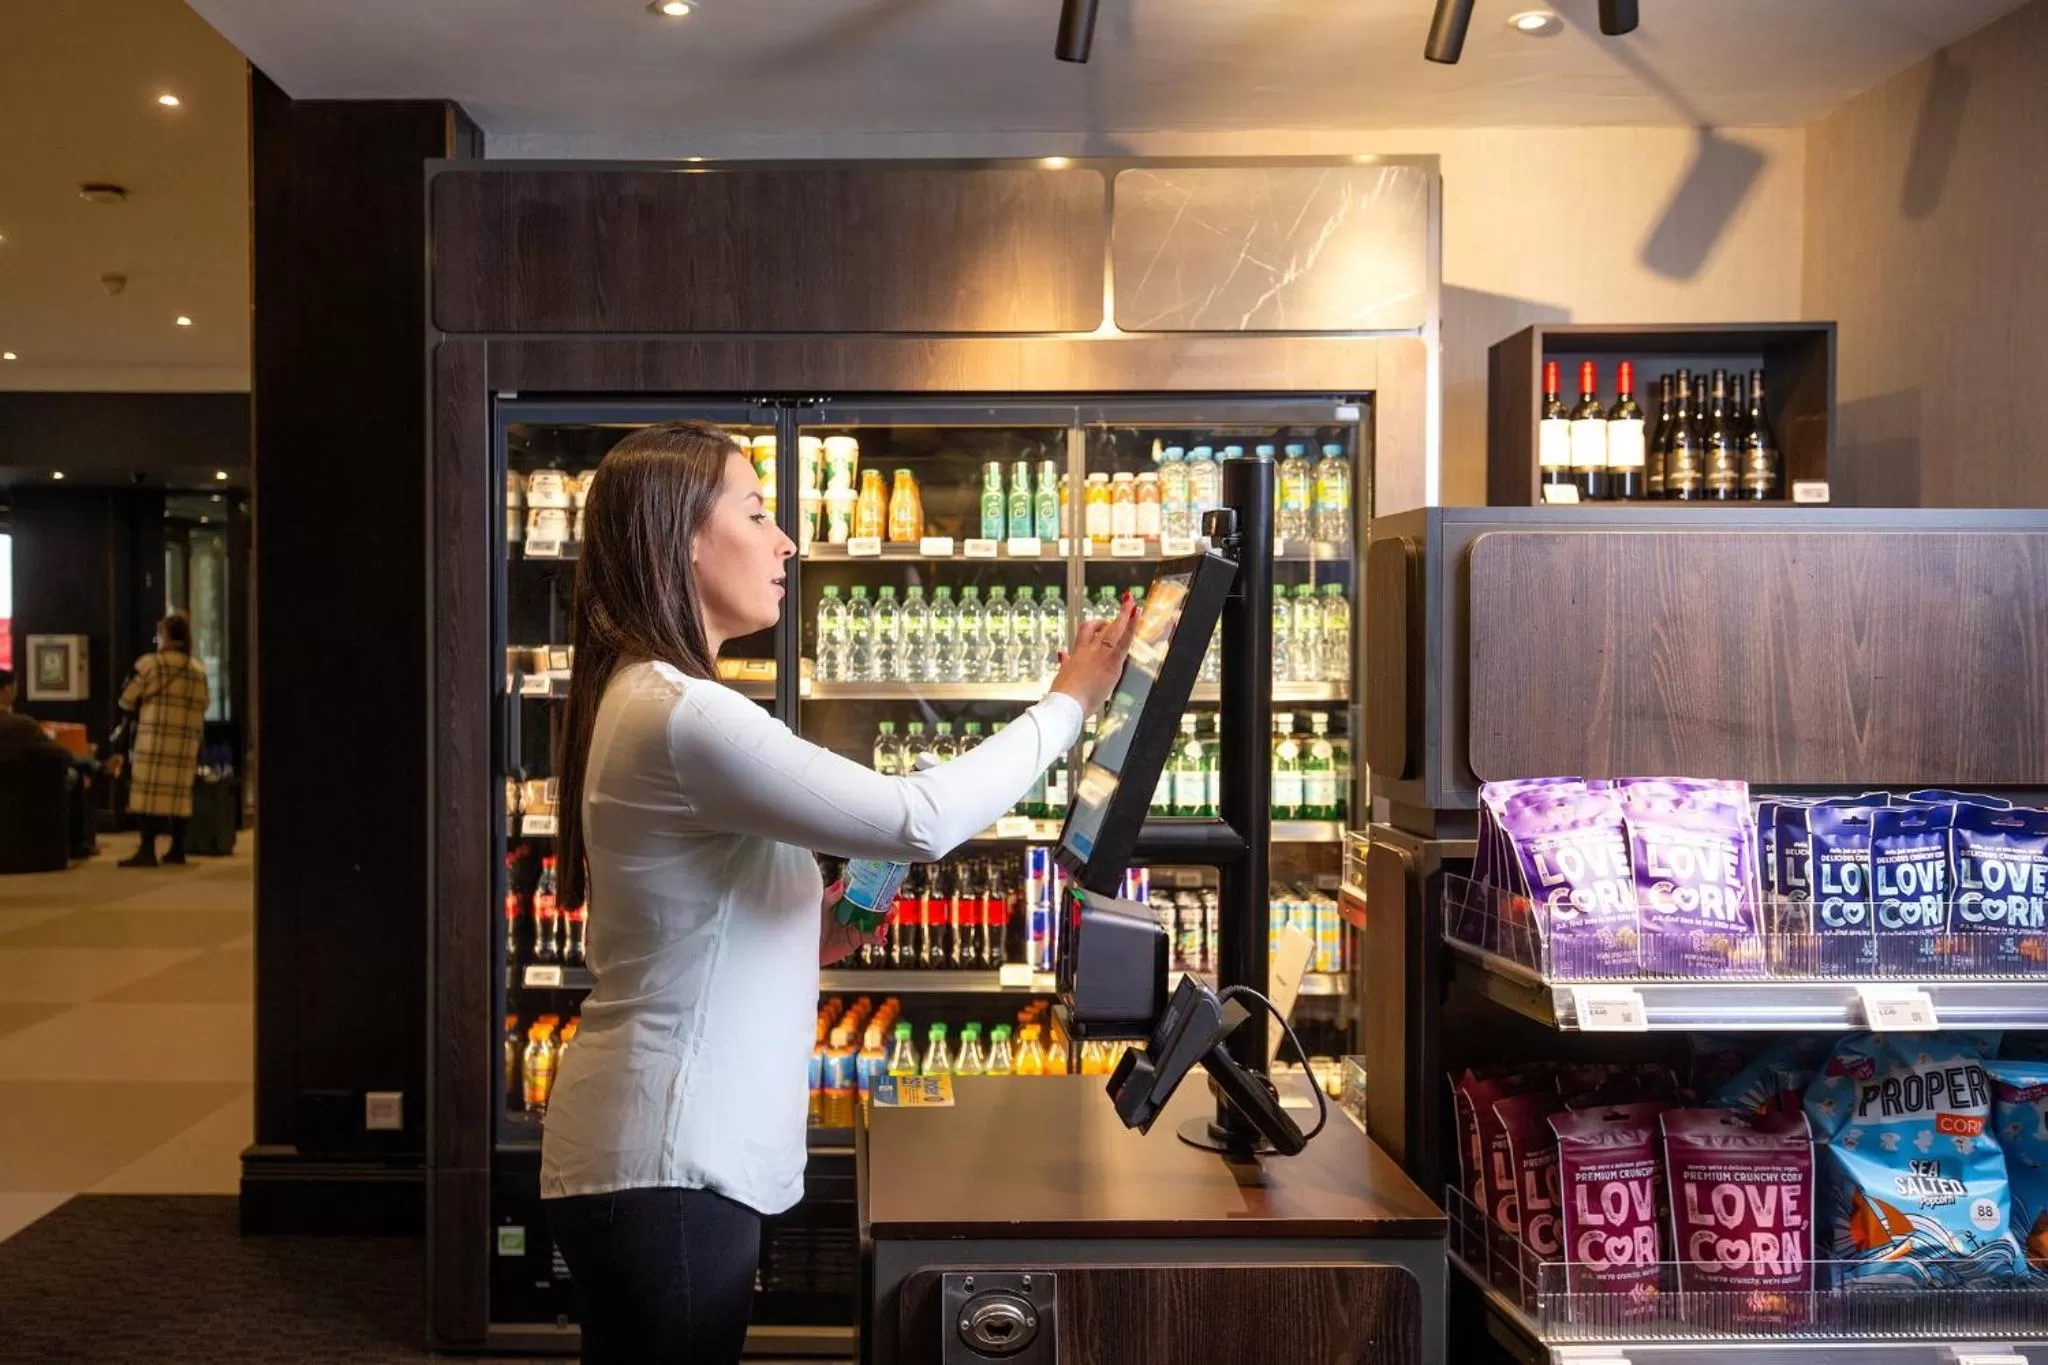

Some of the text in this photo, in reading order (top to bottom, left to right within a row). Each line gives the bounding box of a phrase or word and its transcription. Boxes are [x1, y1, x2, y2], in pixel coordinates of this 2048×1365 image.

[1858, 1066, 1988, 1117] PROPER
[1576, 1171, 1617, 1180] PREMIUM
[1909, 1159, 1938, 1177] SEA
[1684, 1171, 1731, 1181] PREMIUM
[1734, 1172, 1778, 1182] CRUNCHY
[1894, 1176, 1966, 1195] SALTED
[1978, 1205, 1993, 1217] 88
